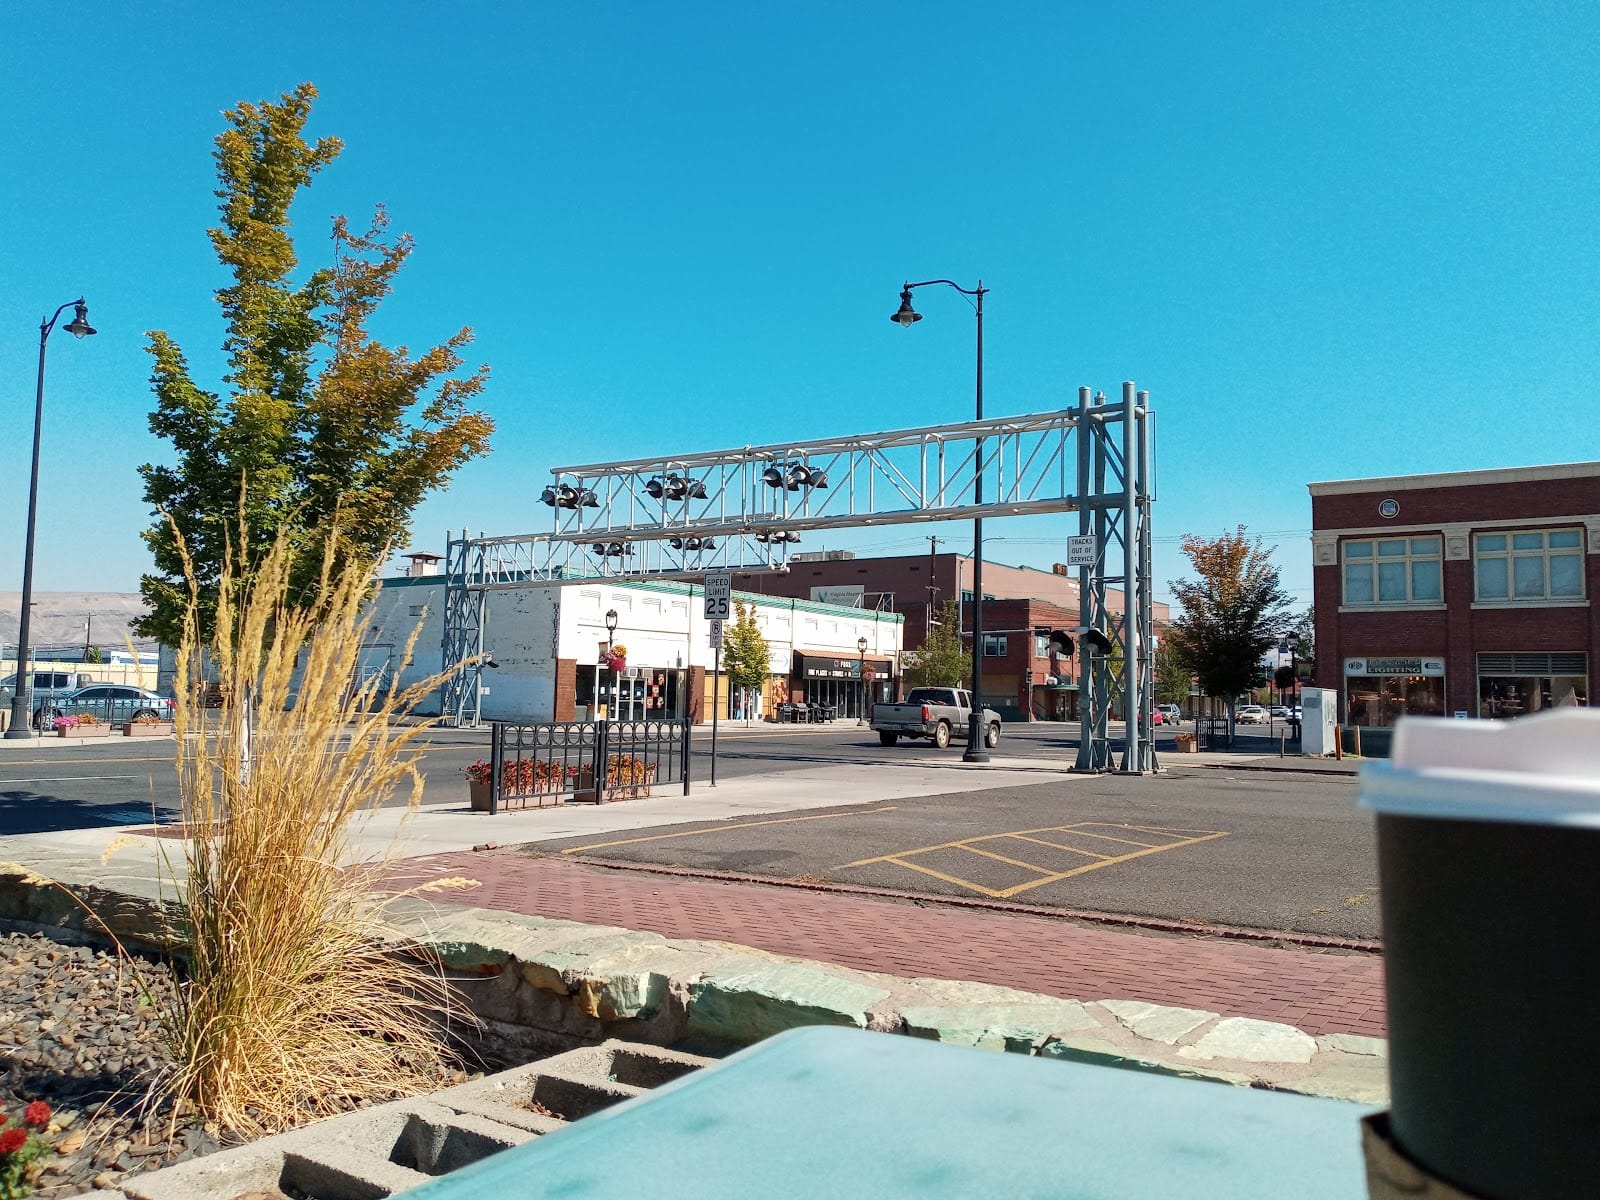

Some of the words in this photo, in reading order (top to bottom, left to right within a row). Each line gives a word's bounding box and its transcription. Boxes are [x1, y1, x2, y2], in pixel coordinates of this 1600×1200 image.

[1070, 555, 1094, 563] SERVICE
[707, 578, 729, 586] SPEED
[708, 588, 726, 596] LIMIT
[706, 597, 728, 615] 25
